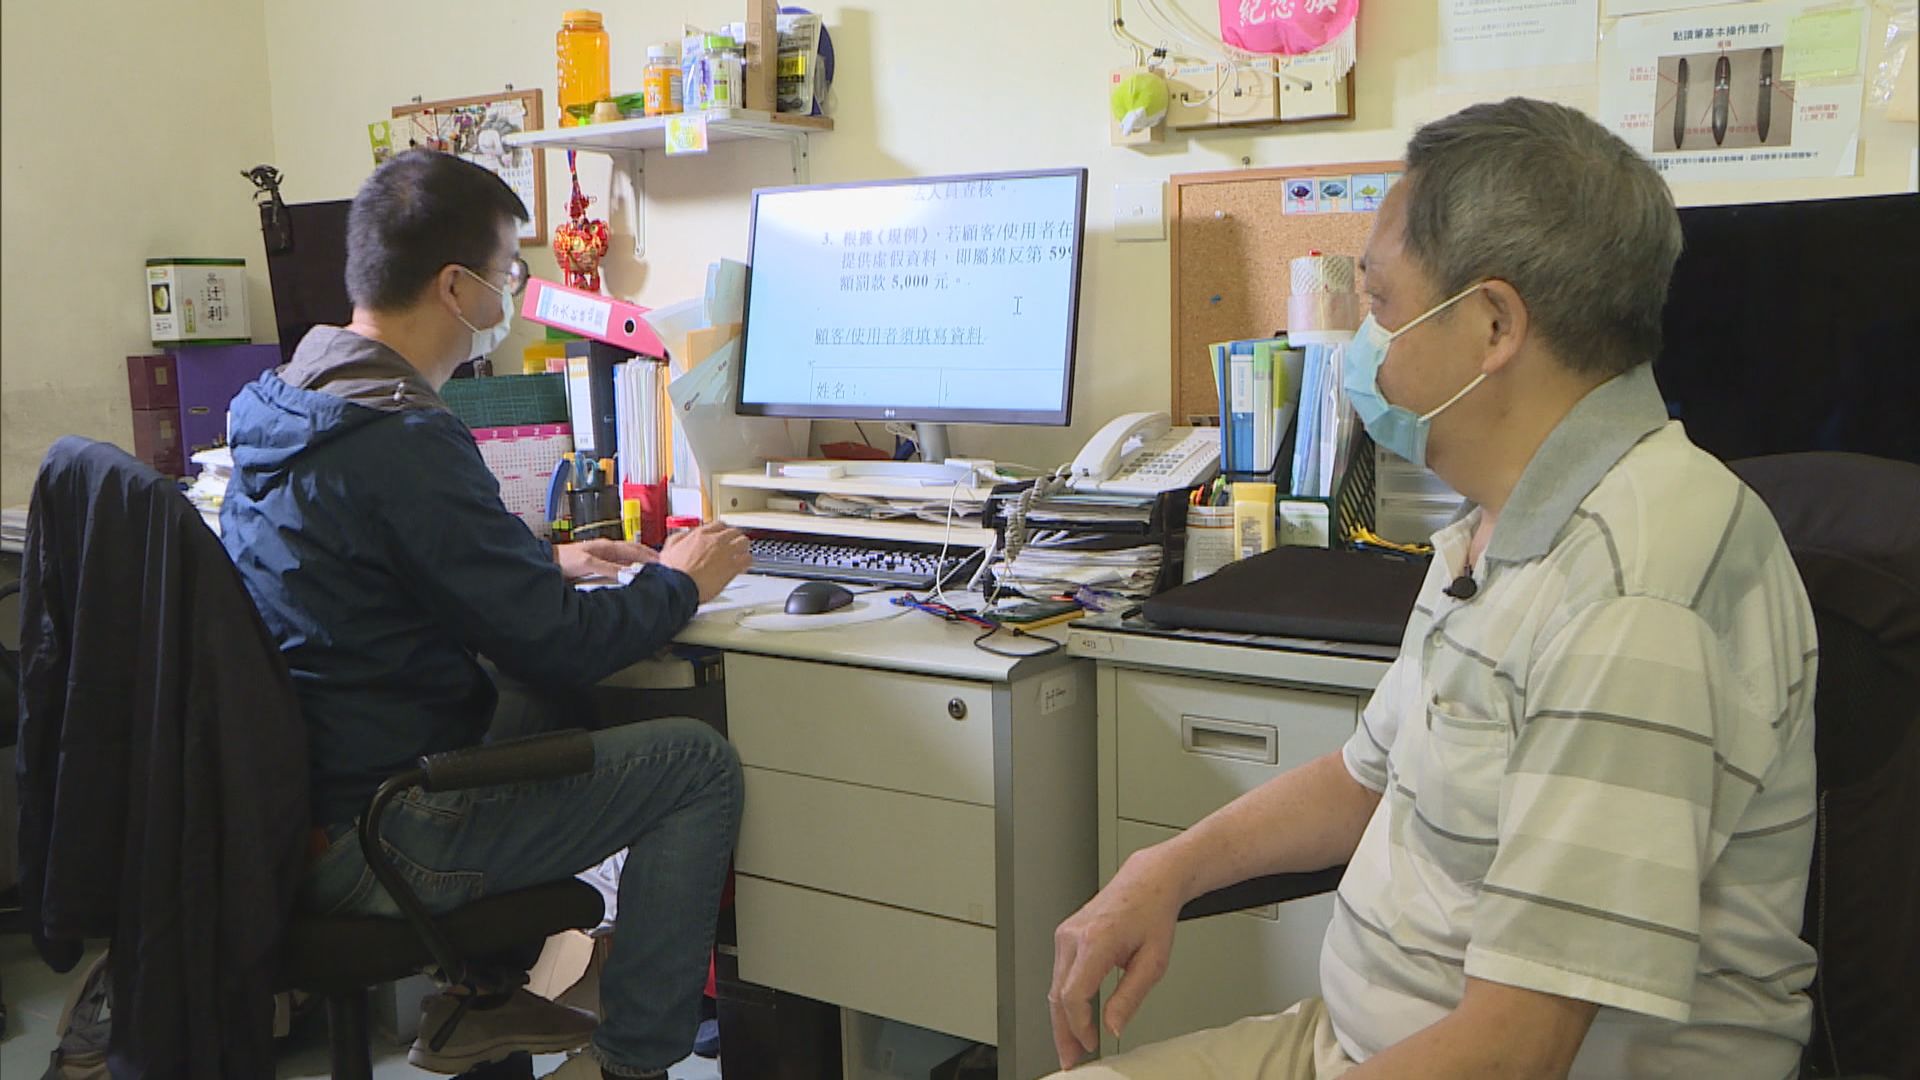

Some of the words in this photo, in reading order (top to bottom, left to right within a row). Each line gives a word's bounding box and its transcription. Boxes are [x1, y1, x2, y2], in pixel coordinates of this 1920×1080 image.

[822, 233, 833, 245] 3.
[839, 275, 885, 292] 額罰款
[891, 274, 929, 291] 5,000
[815, 326, 983, 345] 顧客/使用者須填寫資料
